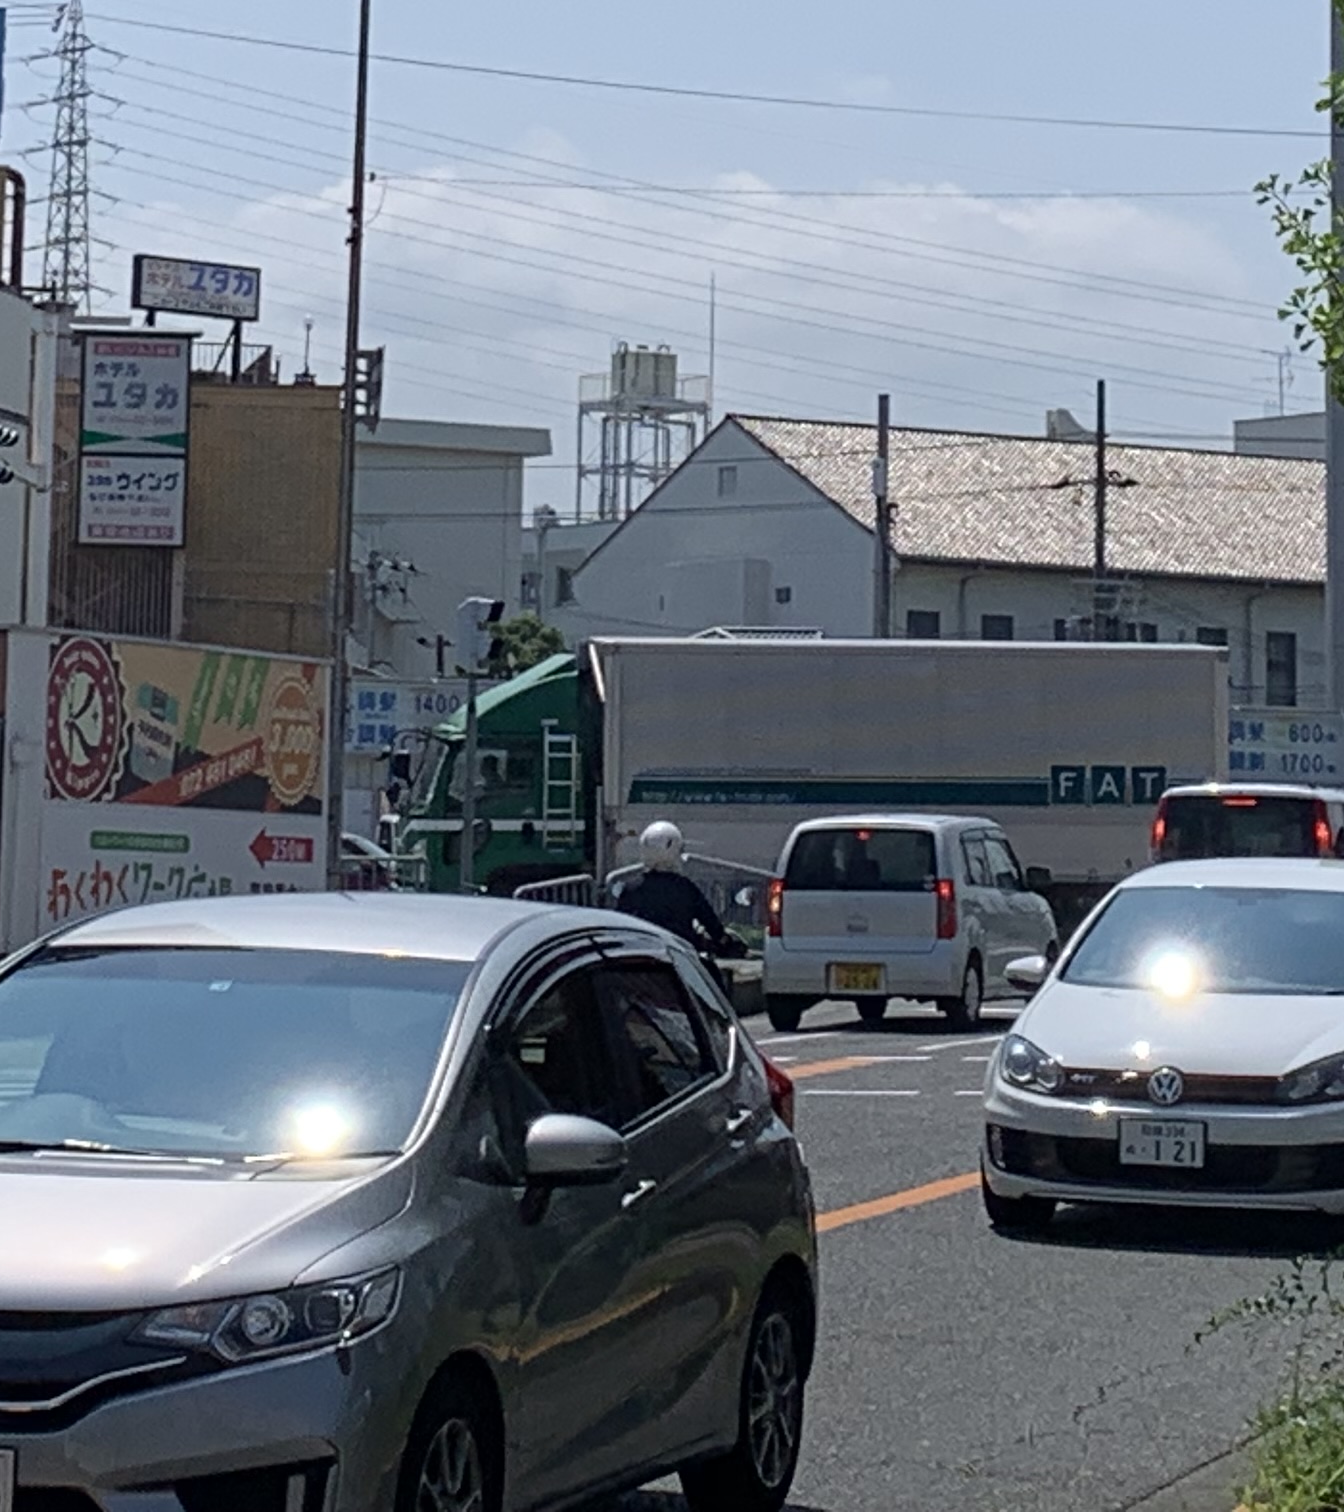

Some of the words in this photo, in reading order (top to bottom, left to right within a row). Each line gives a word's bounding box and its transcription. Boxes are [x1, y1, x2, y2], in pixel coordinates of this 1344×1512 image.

[187, 263, 255, 297] ユタカ
[92, 382, 180, 410] ユタカ
[414, 694, 460, 713] 1400
